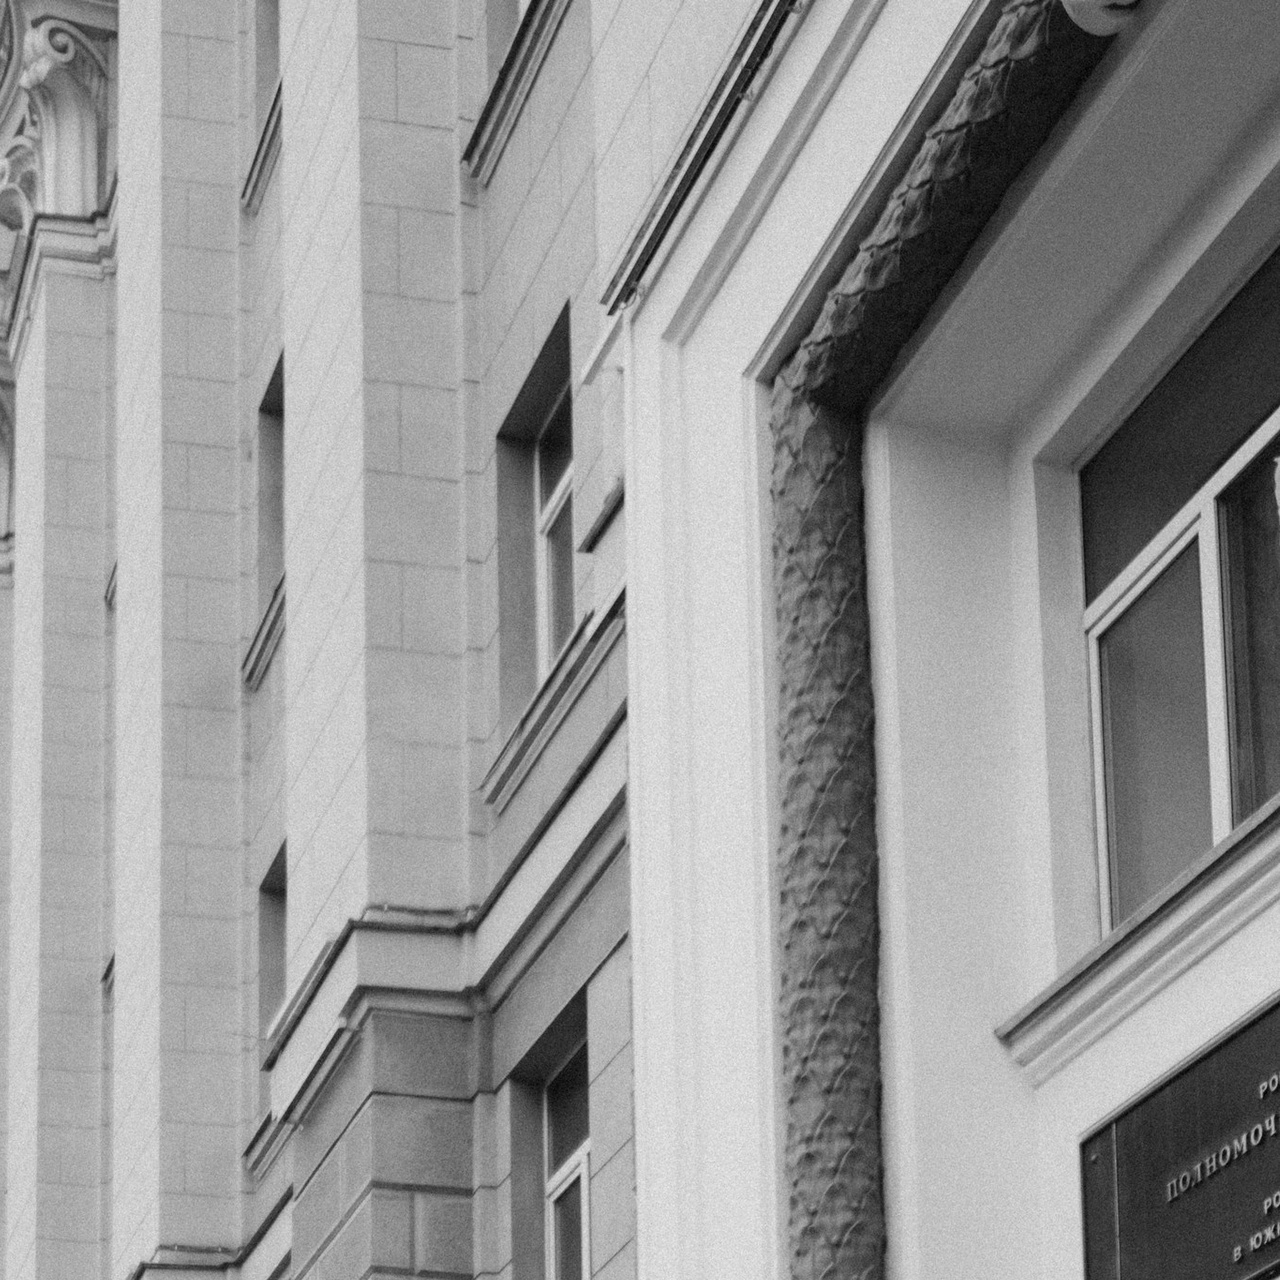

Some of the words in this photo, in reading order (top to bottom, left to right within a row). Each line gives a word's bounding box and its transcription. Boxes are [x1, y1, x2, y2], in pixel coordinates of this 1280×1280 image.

[1259, 1071, 1280, 1099] РО
[1166, 1113, 1277, 1201] ПОЛНОМОЧ
[1233, 1246, 1242, 1263] В
[1250, 1222, 1280, 1251] ЮЖ
